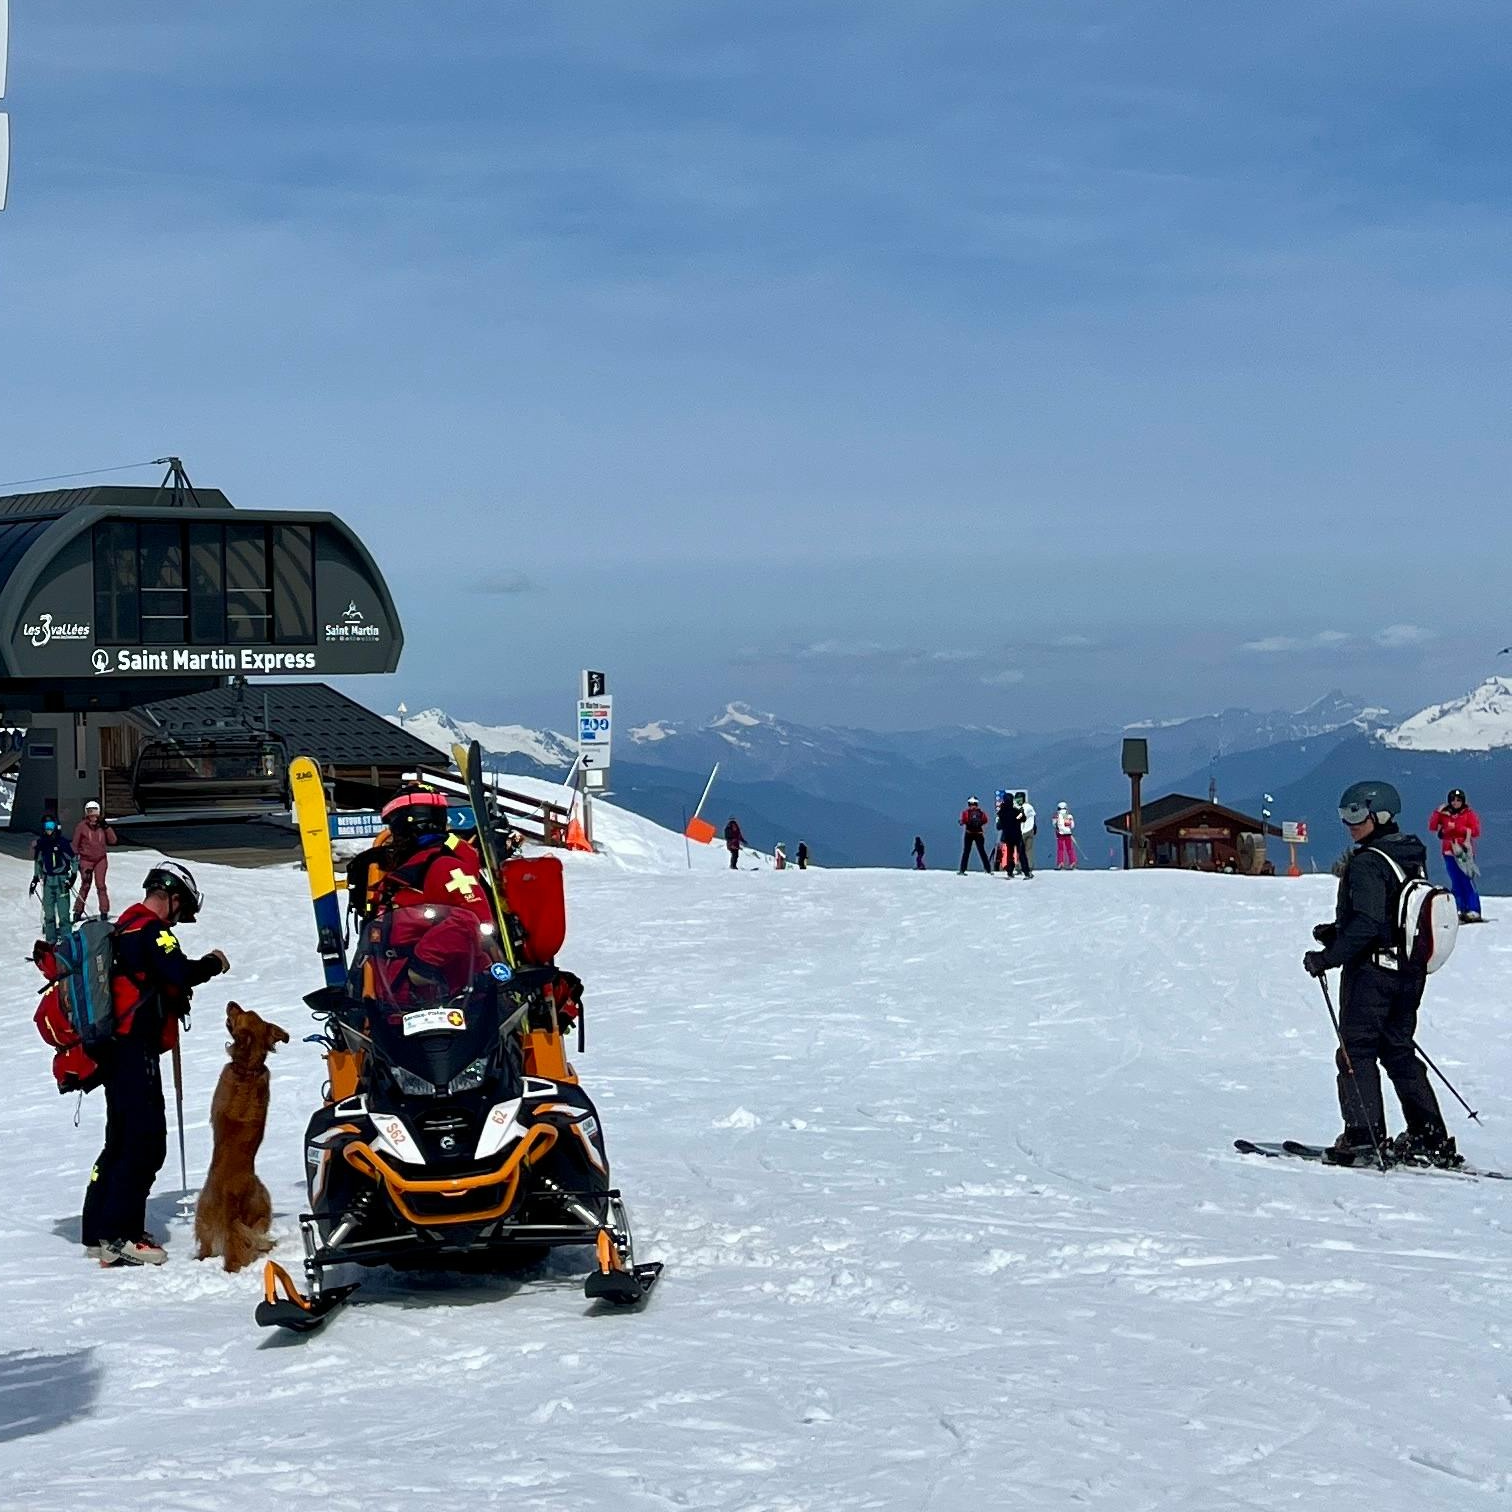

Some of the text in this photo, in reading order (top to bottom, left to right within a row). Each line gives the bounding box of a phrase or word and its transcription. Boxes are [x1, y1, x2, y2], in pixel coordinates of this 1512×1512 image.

[325, 624, 379, 636] Saint Martin
[117, 649, 316, 673] Saint Martin Express
[491, 1109, 508, 1125] 62
[386, 1122, 406, 1145] S62
